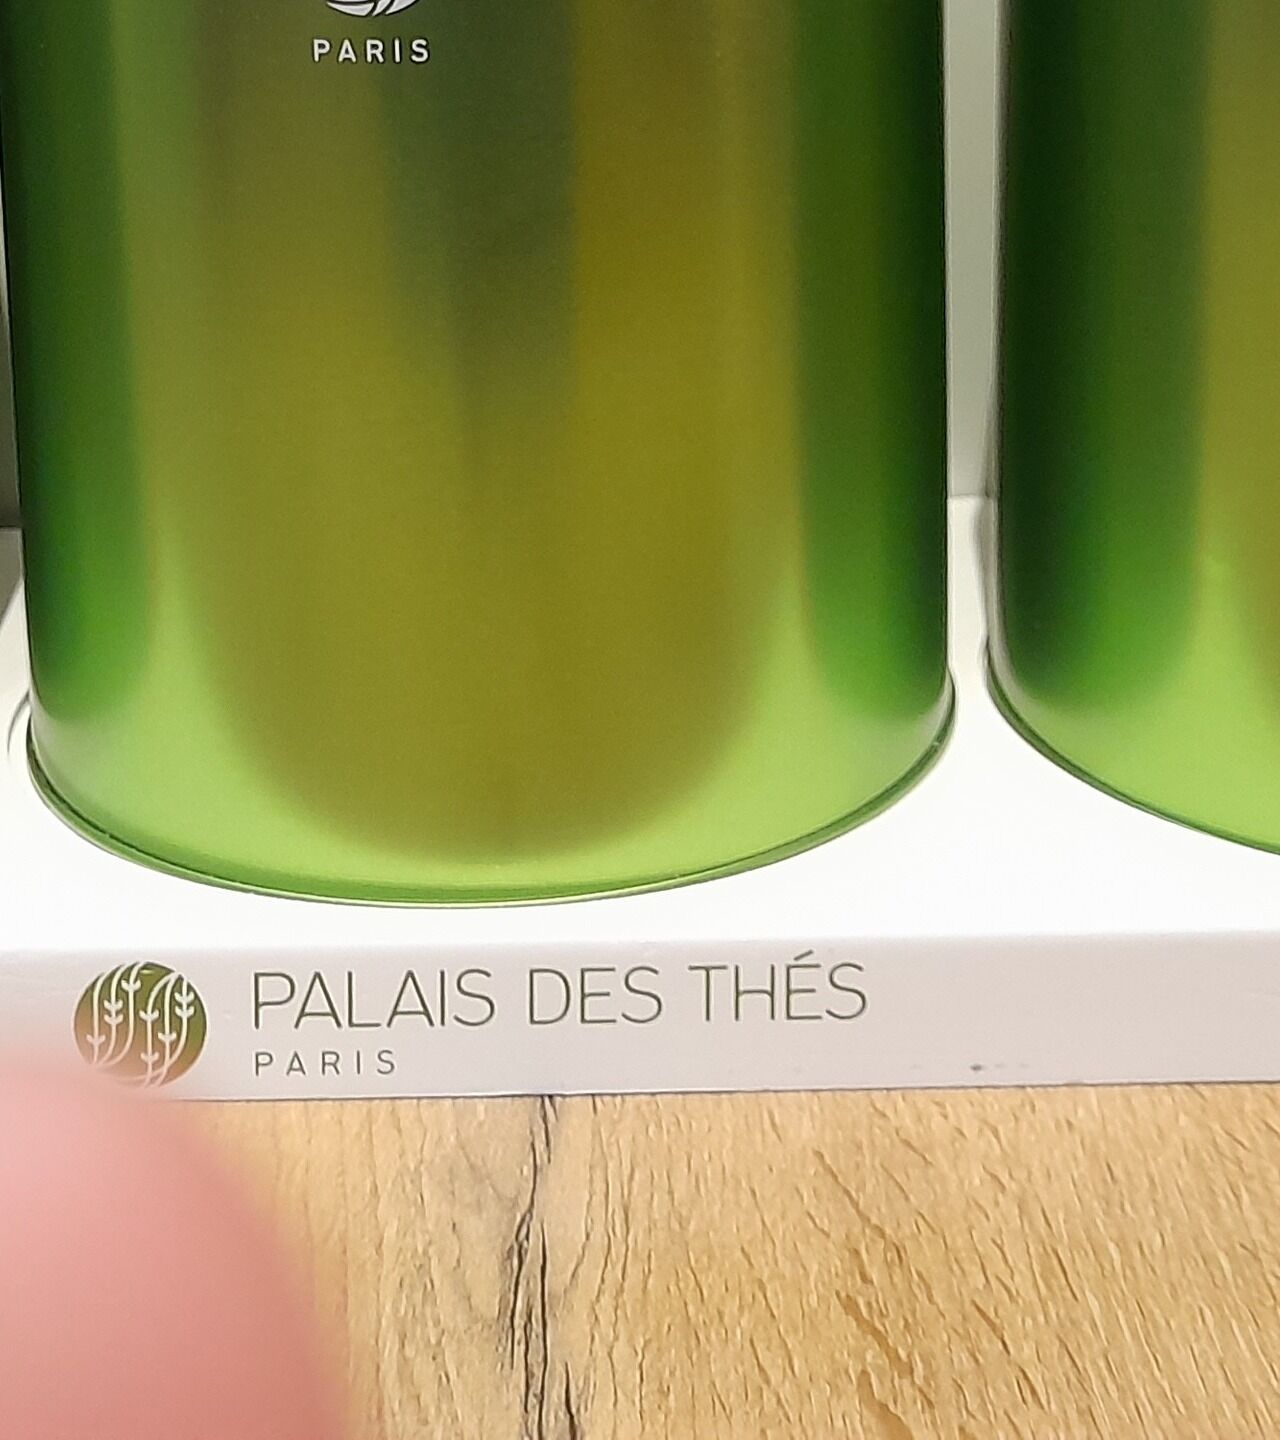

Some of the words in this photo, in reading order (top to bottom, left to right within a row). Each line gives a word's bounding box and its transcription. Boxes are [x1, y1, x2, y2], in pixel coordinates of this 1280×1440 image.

[312, 38, 430, 64] PARIS
[251, 967, 496, 1030] PALAIS
[527, 965, 664, 1026] DES
[687, 950, 868, 1023] THÉS
[253, 1049, 398, 1077] PARIS
